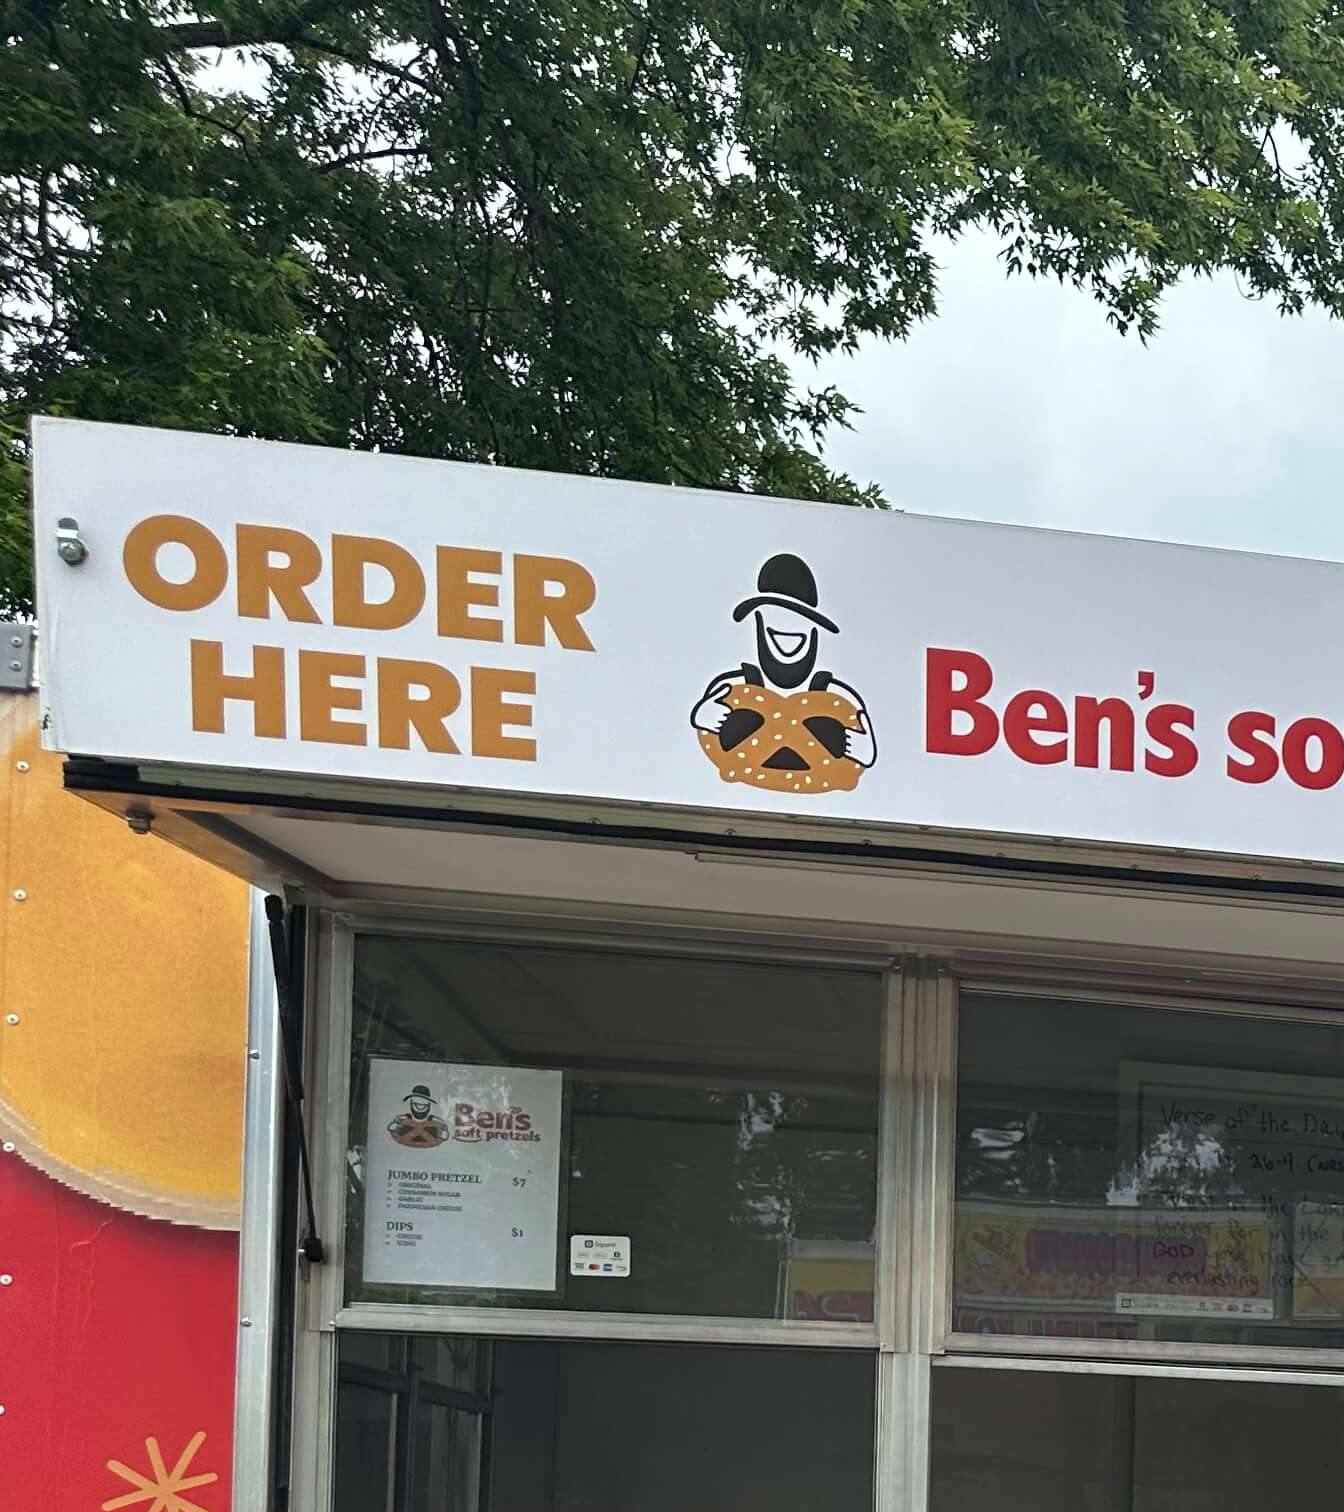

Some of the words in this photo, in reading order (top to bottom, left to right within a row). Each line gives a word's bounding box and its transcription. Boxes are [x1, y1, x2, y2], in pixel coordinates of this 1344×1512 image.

[122, 514, 598, 652] ORDER
[190, 638, 538, 763] HERE
[925, 648, 1199, 779] Ben's
[455, 1103, 532, 1132] Ben's
[1160, 1102, 1215, 1126] Verse
[1225, 1104, 1250, 1129] of
[1256, 1112, 1290, 1133] the
[454, 1128, 481, 1139] soft
[486, 1129, 541, 1142] pretzels
[387, 1170, 428, 1181] JUMBO
[431, 1172, 482, 1184] PRETZEL
[512, 1177, 527, 1188] $7
[386, 1221, 414, 1231] DIPS
[511, 1227, 524, 1237] $1
